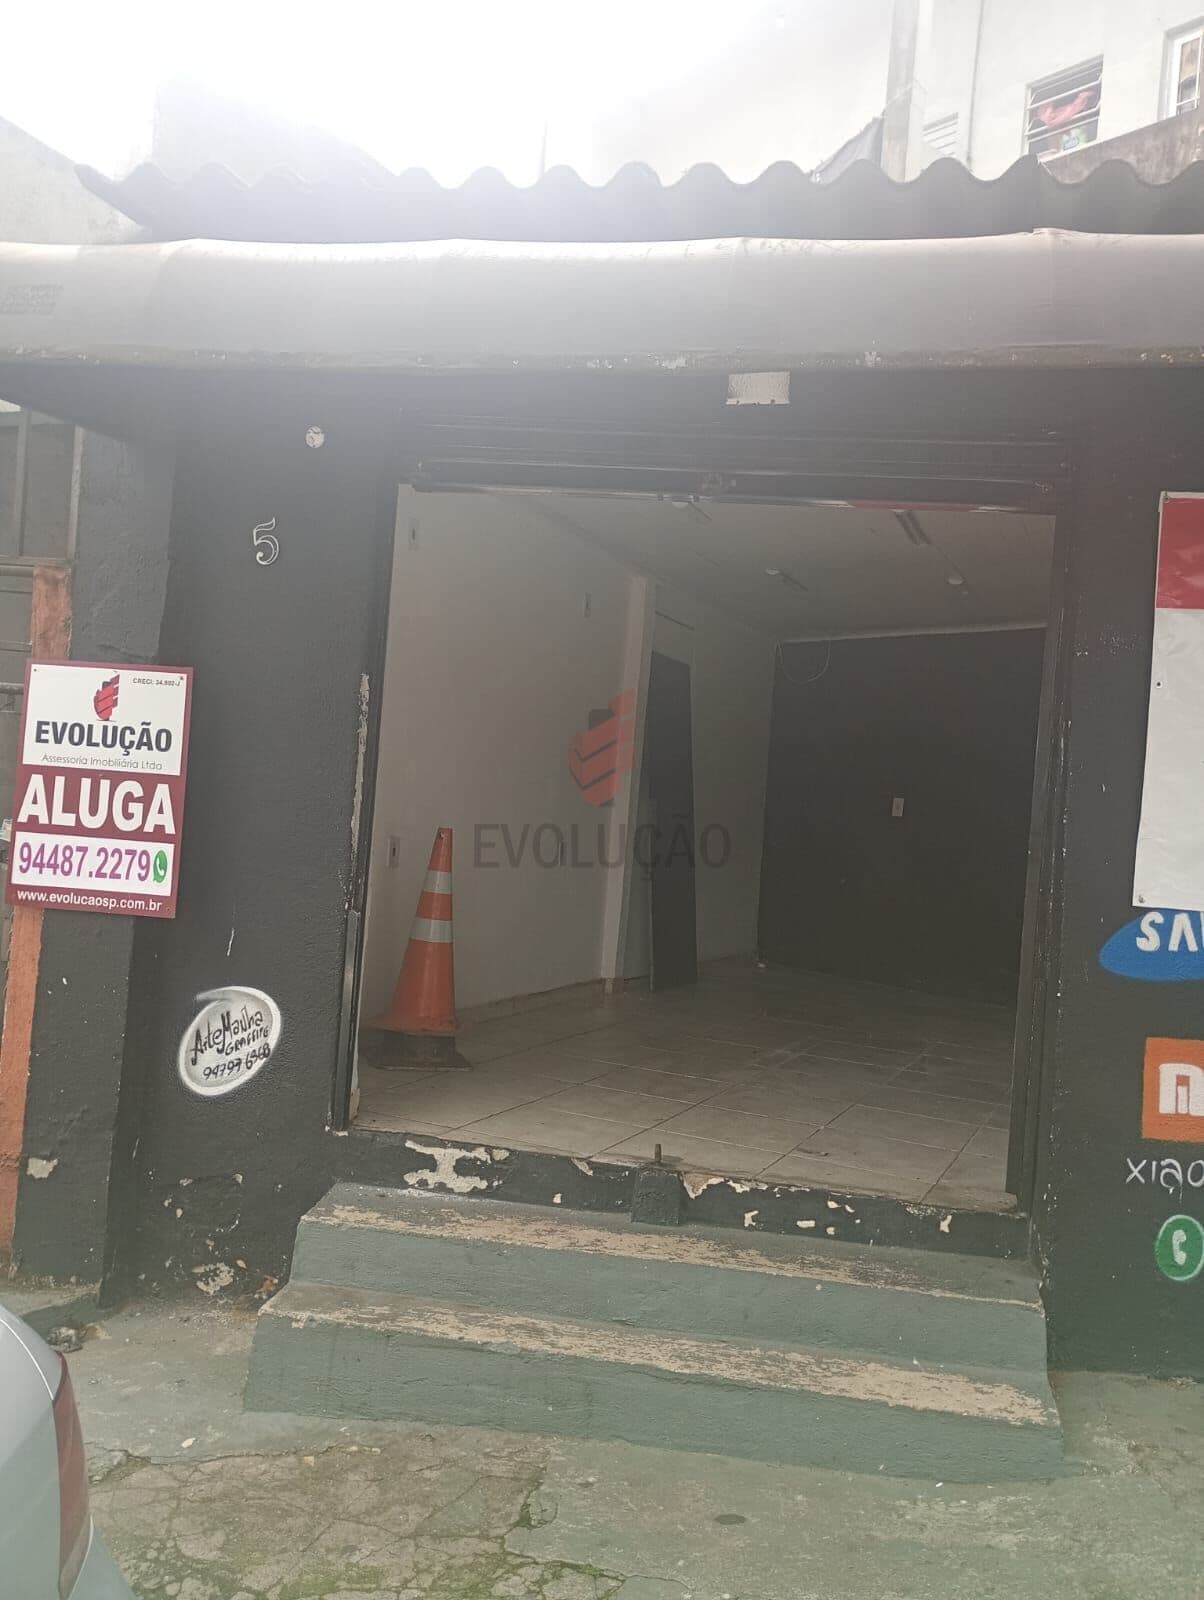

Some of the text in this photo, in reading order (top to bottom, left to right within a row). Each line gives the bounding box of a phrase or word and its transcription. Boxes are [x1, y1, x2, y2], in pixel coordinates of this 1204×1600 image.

[253, 516, 279, 565] 5
[35, 720, 172, 756] EVOLUÇÃO
[42, 754, 163, 770] Assessoria Imobiliária Ltda
[17, 774, 176, 834] ALUGA
[18, 842, 151, 882] 94487.2279
[17, 890, 162, 911] www.evolucaosp.com.br
[1136, 911, 1204, 952] SA
